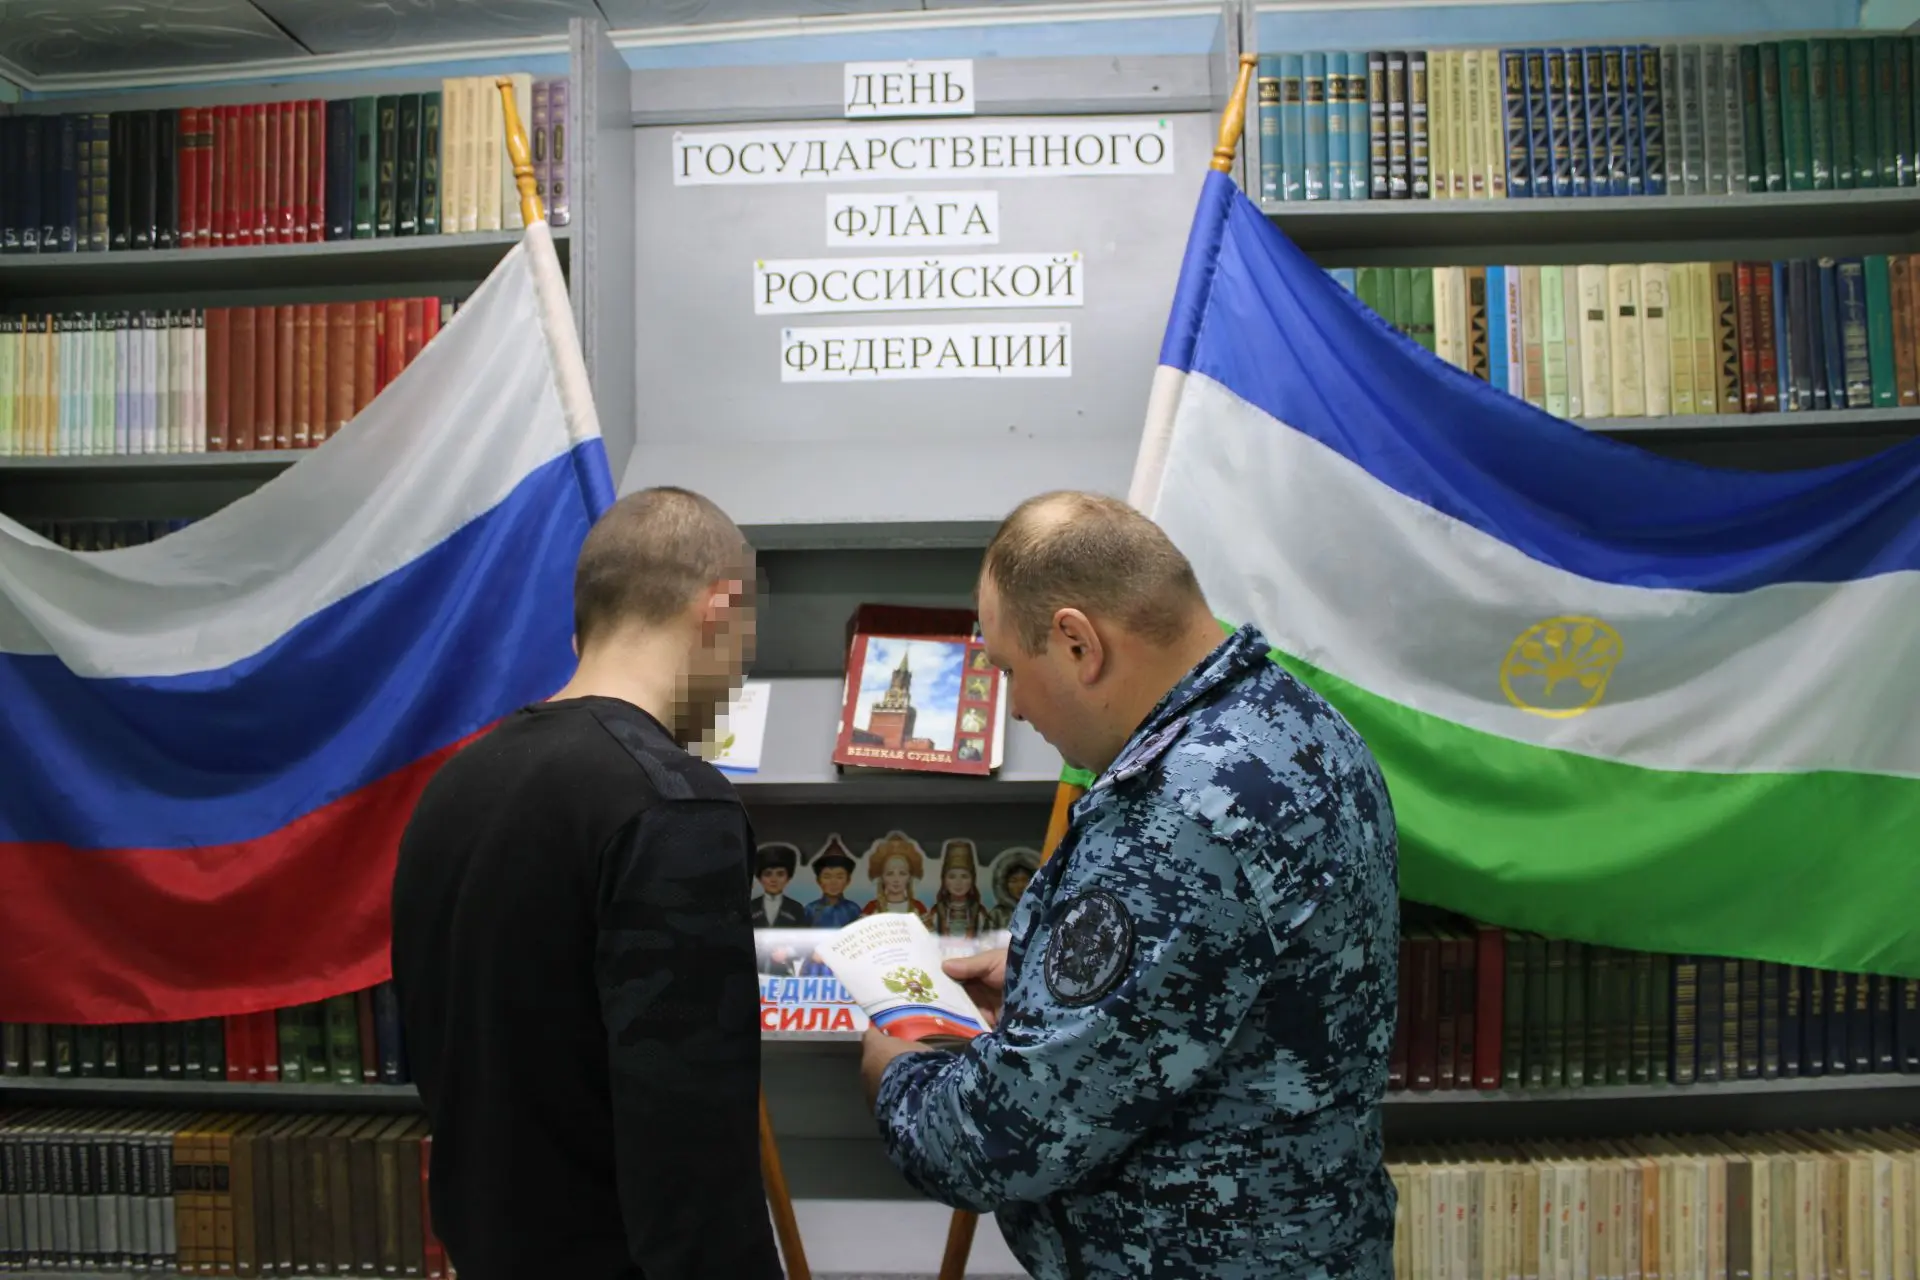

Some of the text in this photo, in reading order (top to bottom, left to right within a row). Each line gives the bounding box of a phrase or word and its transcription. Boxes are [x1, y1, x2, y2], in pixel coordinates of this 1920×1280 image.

[847, 73, 966, 112] ДЕНЬ
[681, 132, 1165, 178] ГОСУДАРСТВЕННОГО
[833, 202, 993, 237] ФЛАГА
[763, 257, 1076, 305] РОССИЙСКОЙ
[784, 334, 1068, 375] ФЕДЕРАЦИИ
[847, 746, 952, 764] ВЕЛИКАЯ СУДЬБА
[761, 1007, 854, 1031] СИЛА
